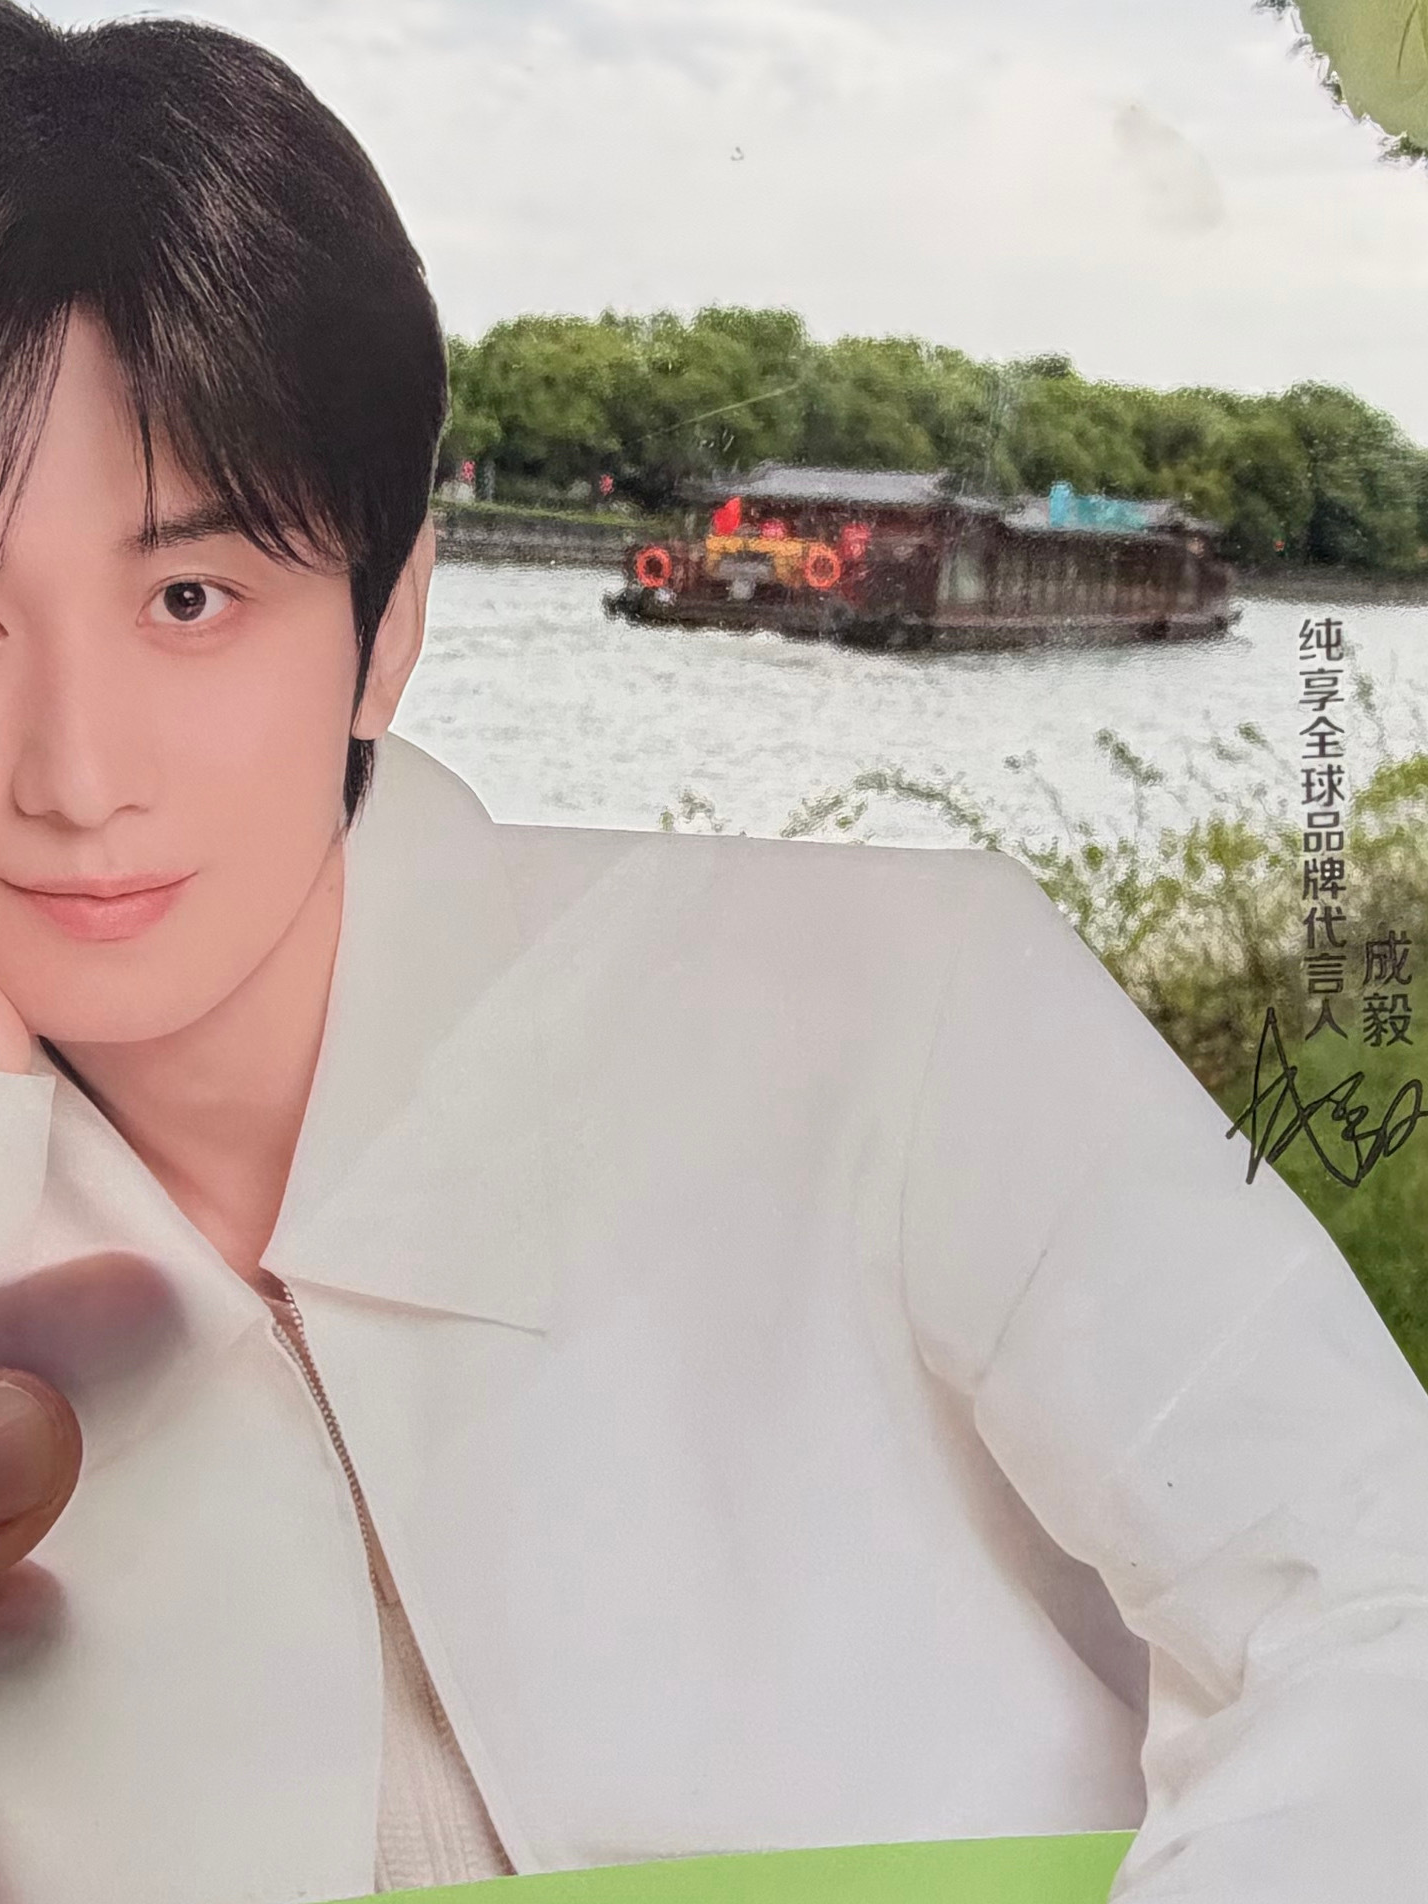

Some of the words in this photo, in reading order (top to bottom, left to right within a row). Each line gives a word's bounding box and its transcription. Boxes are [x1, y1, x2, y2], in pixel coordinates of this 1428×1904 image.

[1298, 617, 1349, 1043] 纯享全球品牌代言人
[1362, 929, 1414, 1049] 成毅
